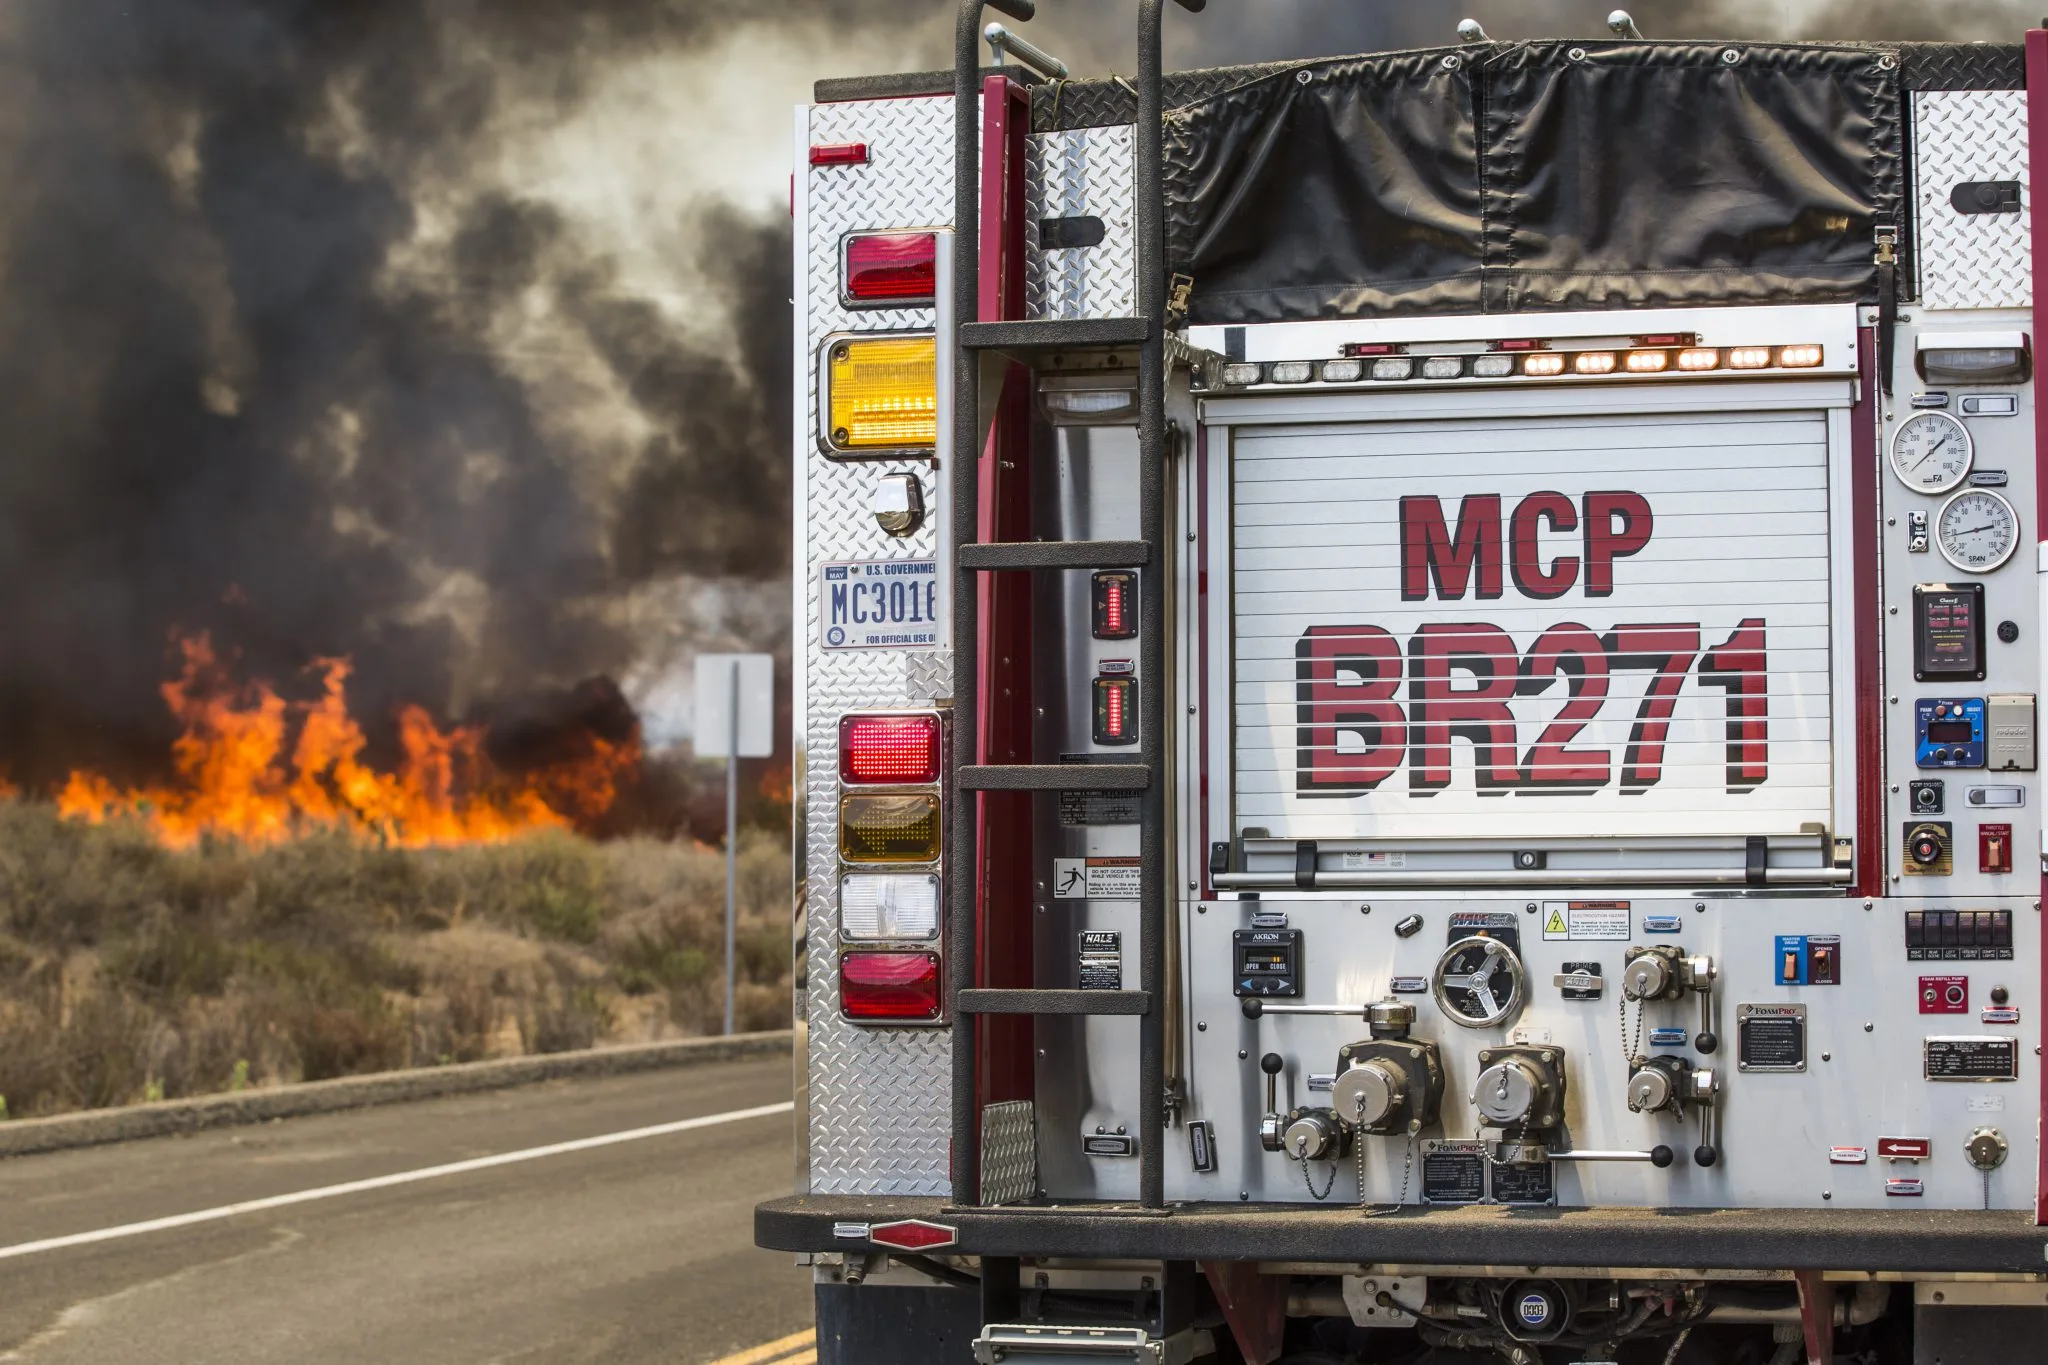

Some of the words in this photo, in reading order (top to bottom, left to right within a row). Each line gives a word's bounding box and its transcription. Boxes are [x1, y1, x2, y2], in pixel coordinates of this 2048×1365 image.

[1399, 490, 1654, 602] MCP
[866, 565, 883, 575] U.S.
[866, 636, 880, 644] FOR
[882, 635, 912, 644] OFFICIAL
[913, 634, 927, 643] USE
[1296, 618, 1768, 799] BR271
[1086, 934, 1114, 944] HALE
